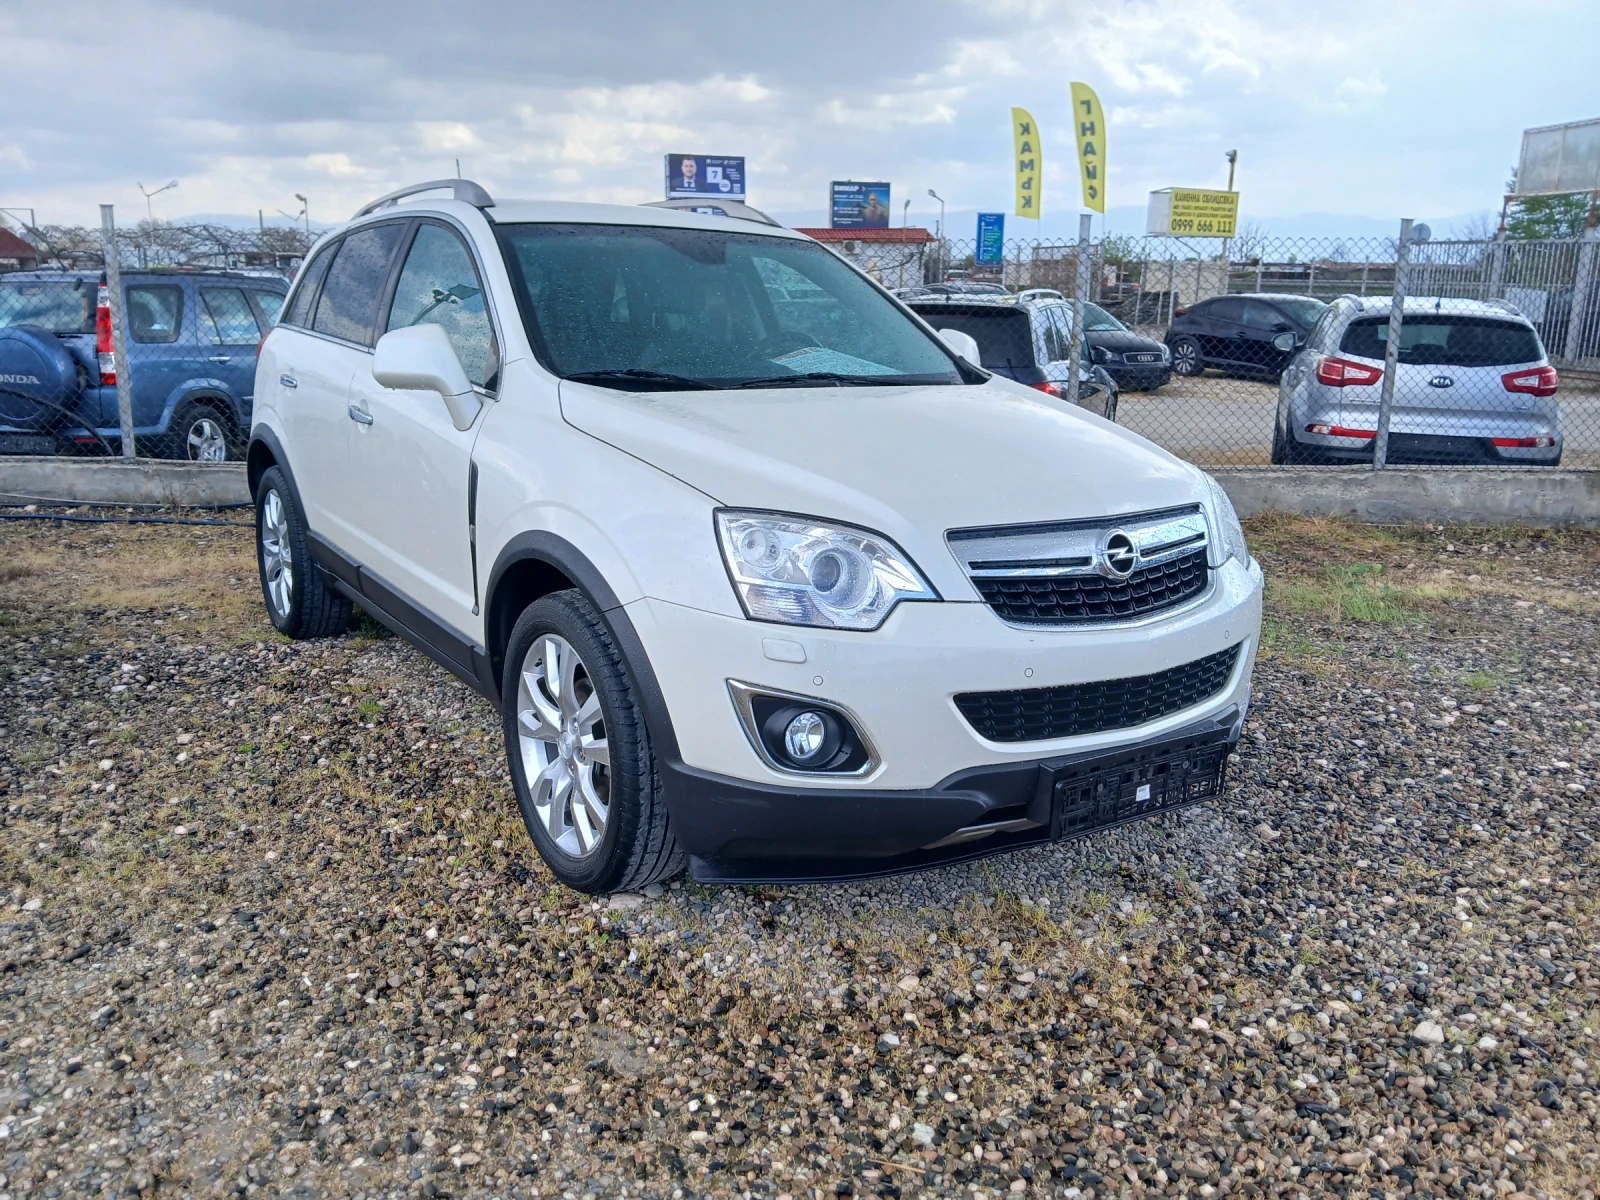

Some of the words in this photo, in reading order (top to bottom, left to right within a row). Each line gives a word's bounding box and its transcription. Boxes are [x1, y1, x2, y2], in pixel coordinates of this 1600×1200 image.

[711, 170, 719, 180] 7
[1175, 193, 1200, 203] КАМЕННА
[1202, 194, 1234, 204] ОБЛИЦОВКА
[1171, 218, 1193, 231] 0999
[1197, 219, 1213, 232] 666
[1216, 221, 1232, 233] 111
[1432, 377, 1451, 387] KIA
